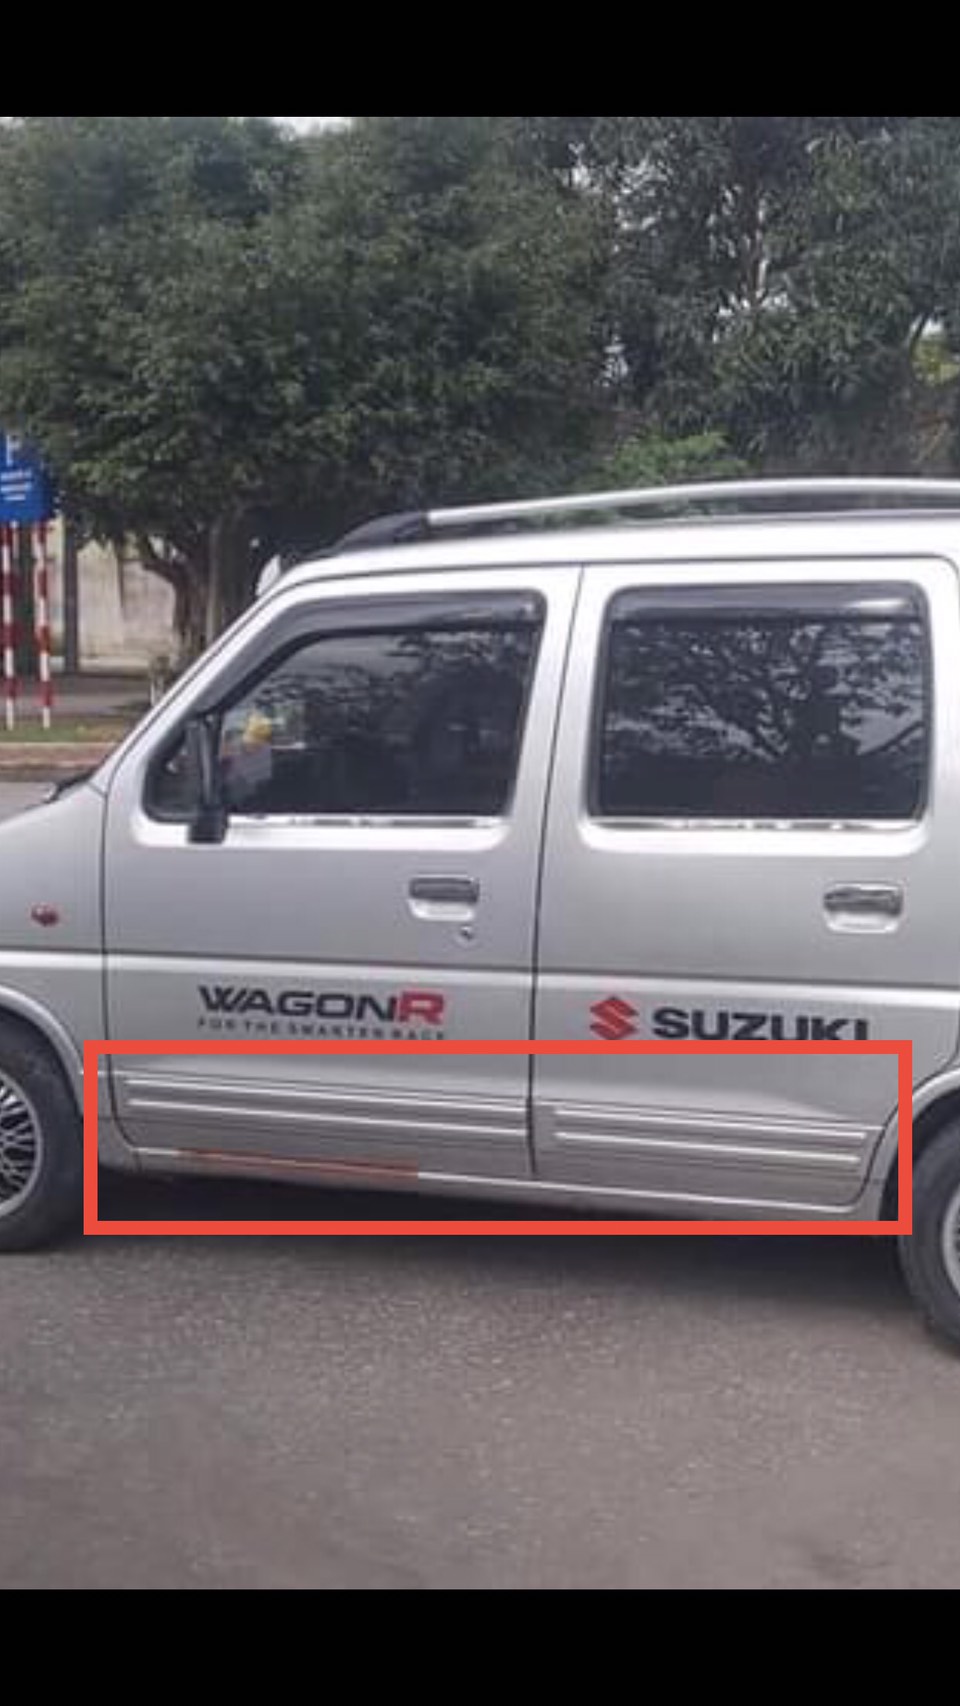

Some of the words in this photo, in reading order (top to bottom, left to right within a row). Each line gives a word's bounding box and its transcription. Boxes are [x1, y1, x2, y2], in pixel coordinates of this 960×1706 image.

[198, 985, 445, 1025] WAGONR
[197, 1016, 235, 1032] FOR
[243, 1019, 279, 1034] THE
[652, 1006, 869, 1040] SUZUKI
